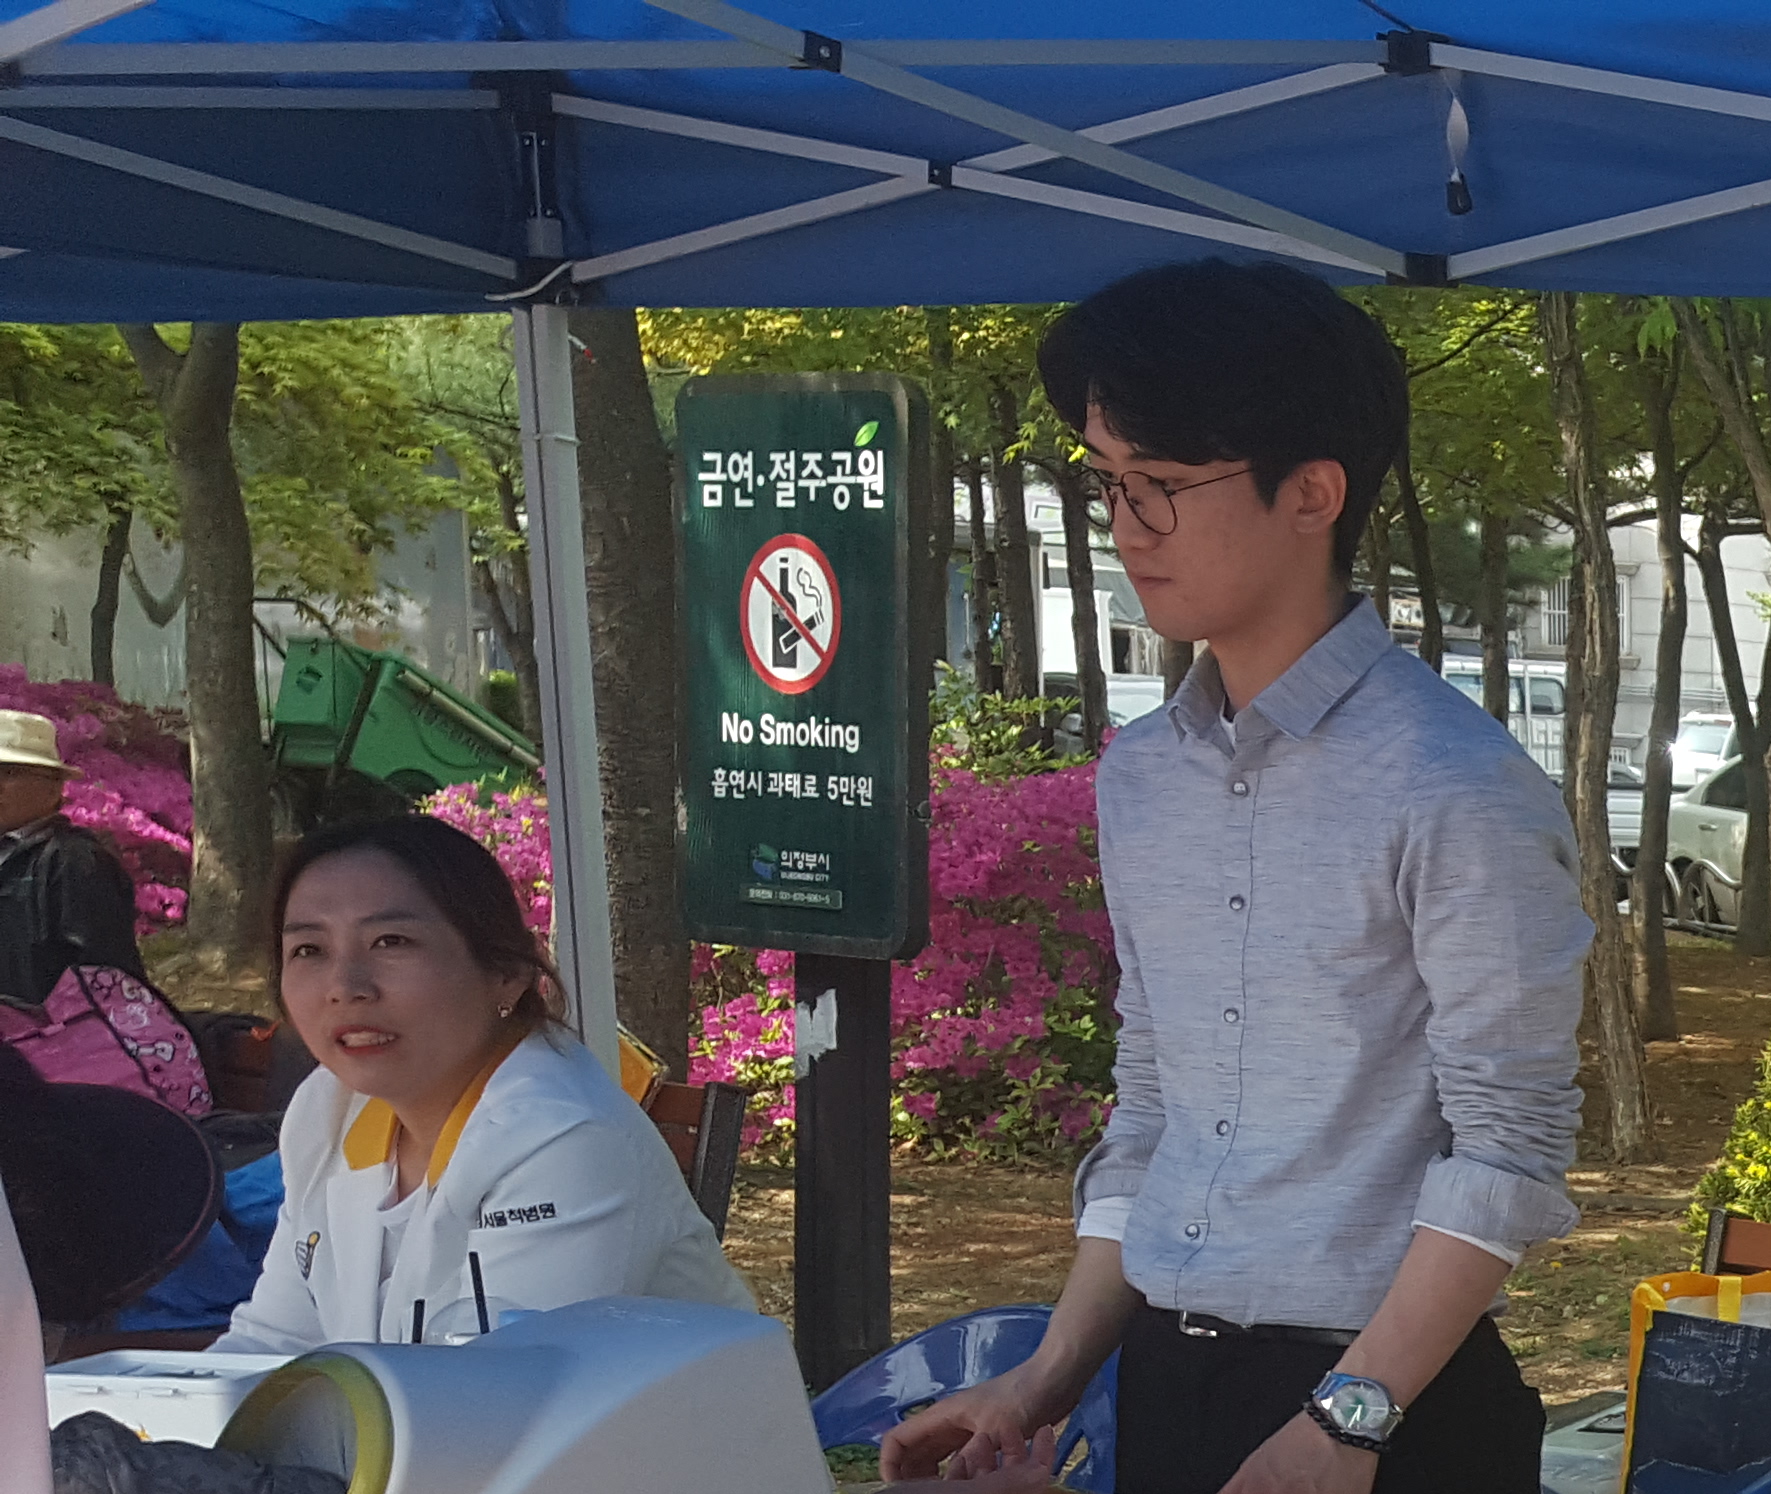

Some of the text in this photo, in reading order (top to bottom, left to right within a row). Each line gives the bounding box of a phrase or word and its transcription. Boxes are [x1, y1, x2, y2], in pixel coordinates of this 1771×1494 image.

[722, 712, 860, 752] No Smoking
[712, 768, 873, 806] 흡연시 과태료 5만원
[781, 850, 829, 871] 의정부시
